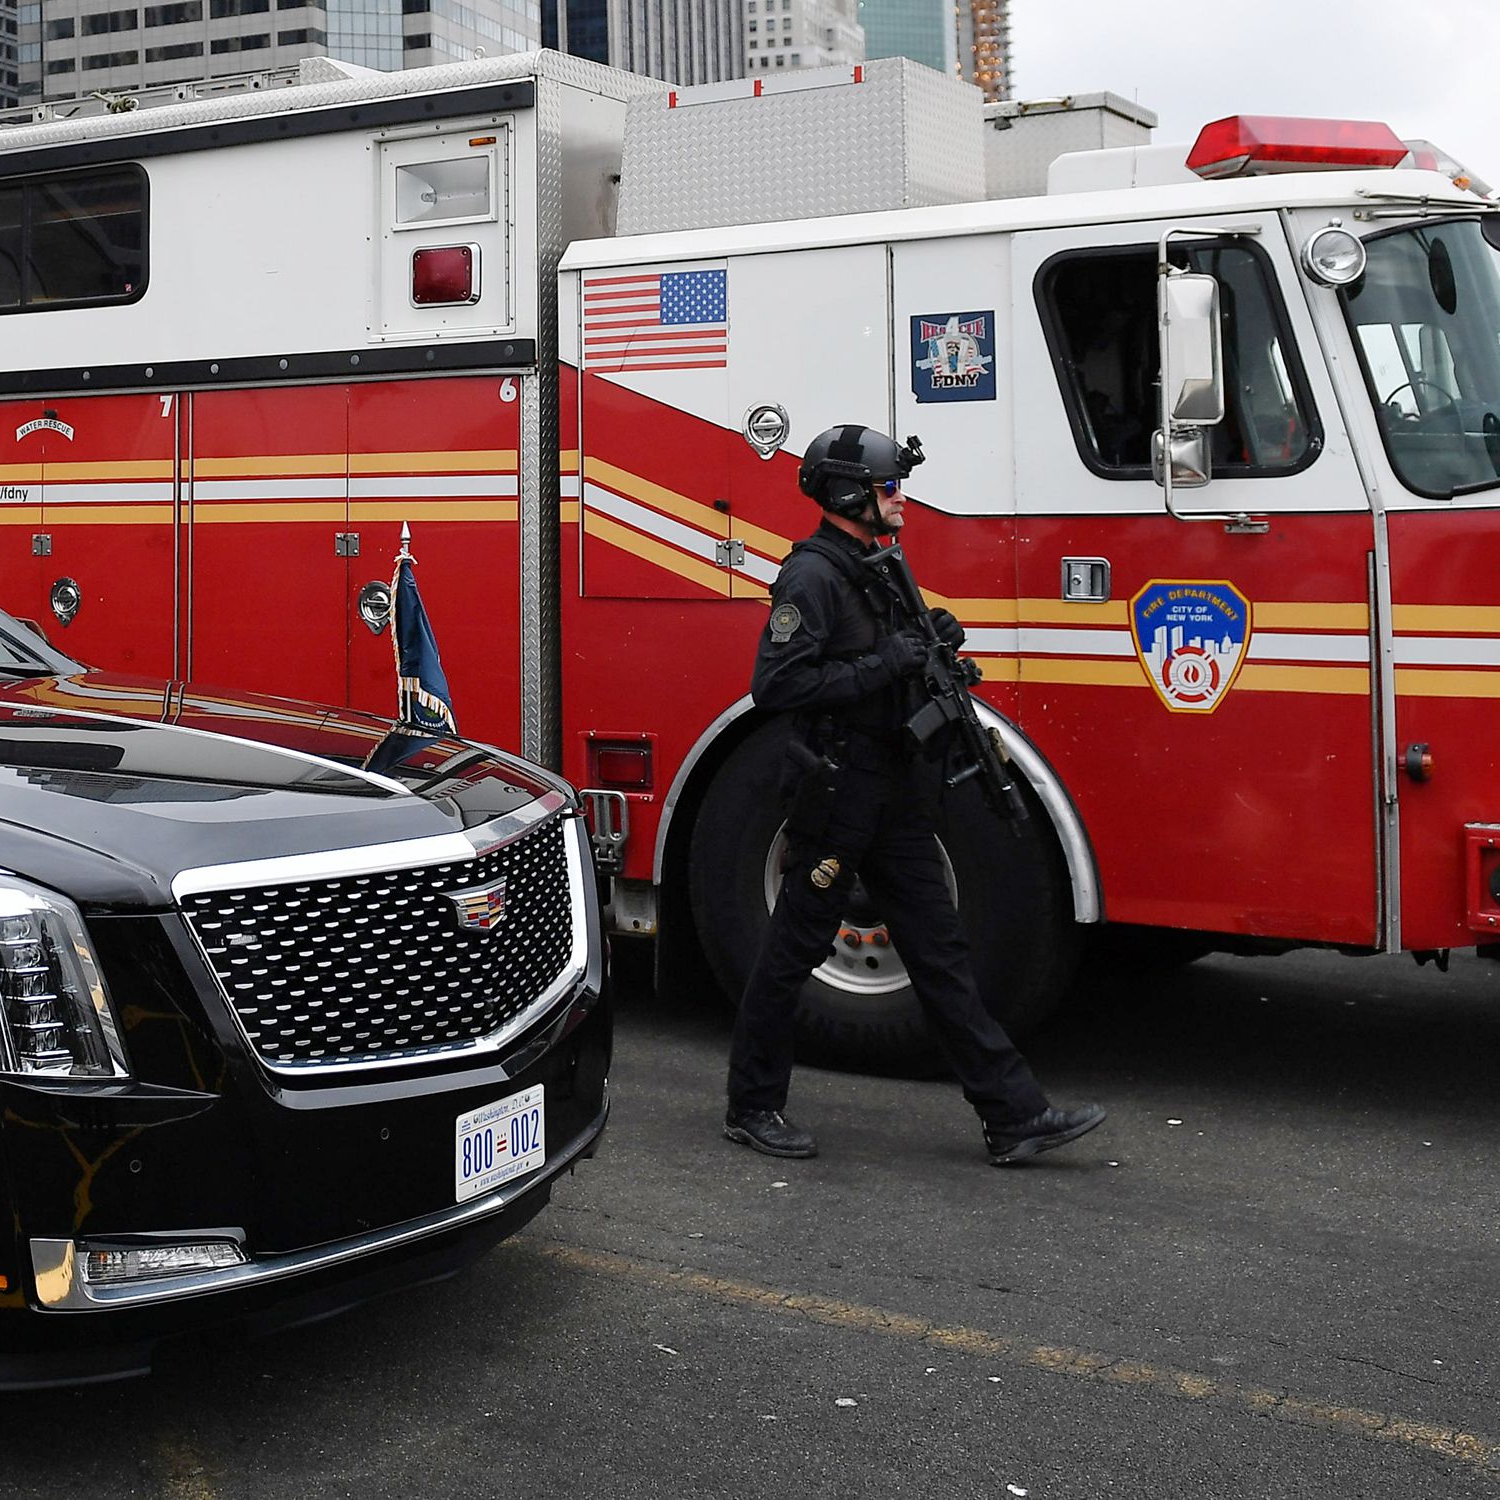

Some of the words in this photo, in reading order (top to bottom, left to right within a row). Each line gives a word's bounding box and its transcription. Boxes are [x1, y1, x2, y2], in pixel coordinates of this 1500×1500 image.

[499, 377, 517, 402] 6
[931, 373, 979, 389] FDNY
[159, 395, 175, 417] 7
[19, 420, 43, 436] WATER
[43, 420, 72, 435] RESCUE
[1143, 598, 1165, 618] FIRE
[1169, 589, 1238, 620] DEPARTMENT
[1166, 614, 1186, 622] NEW
[463, 1128, 493, 1178] 800
[511, 1109, 539, 1157] 002
